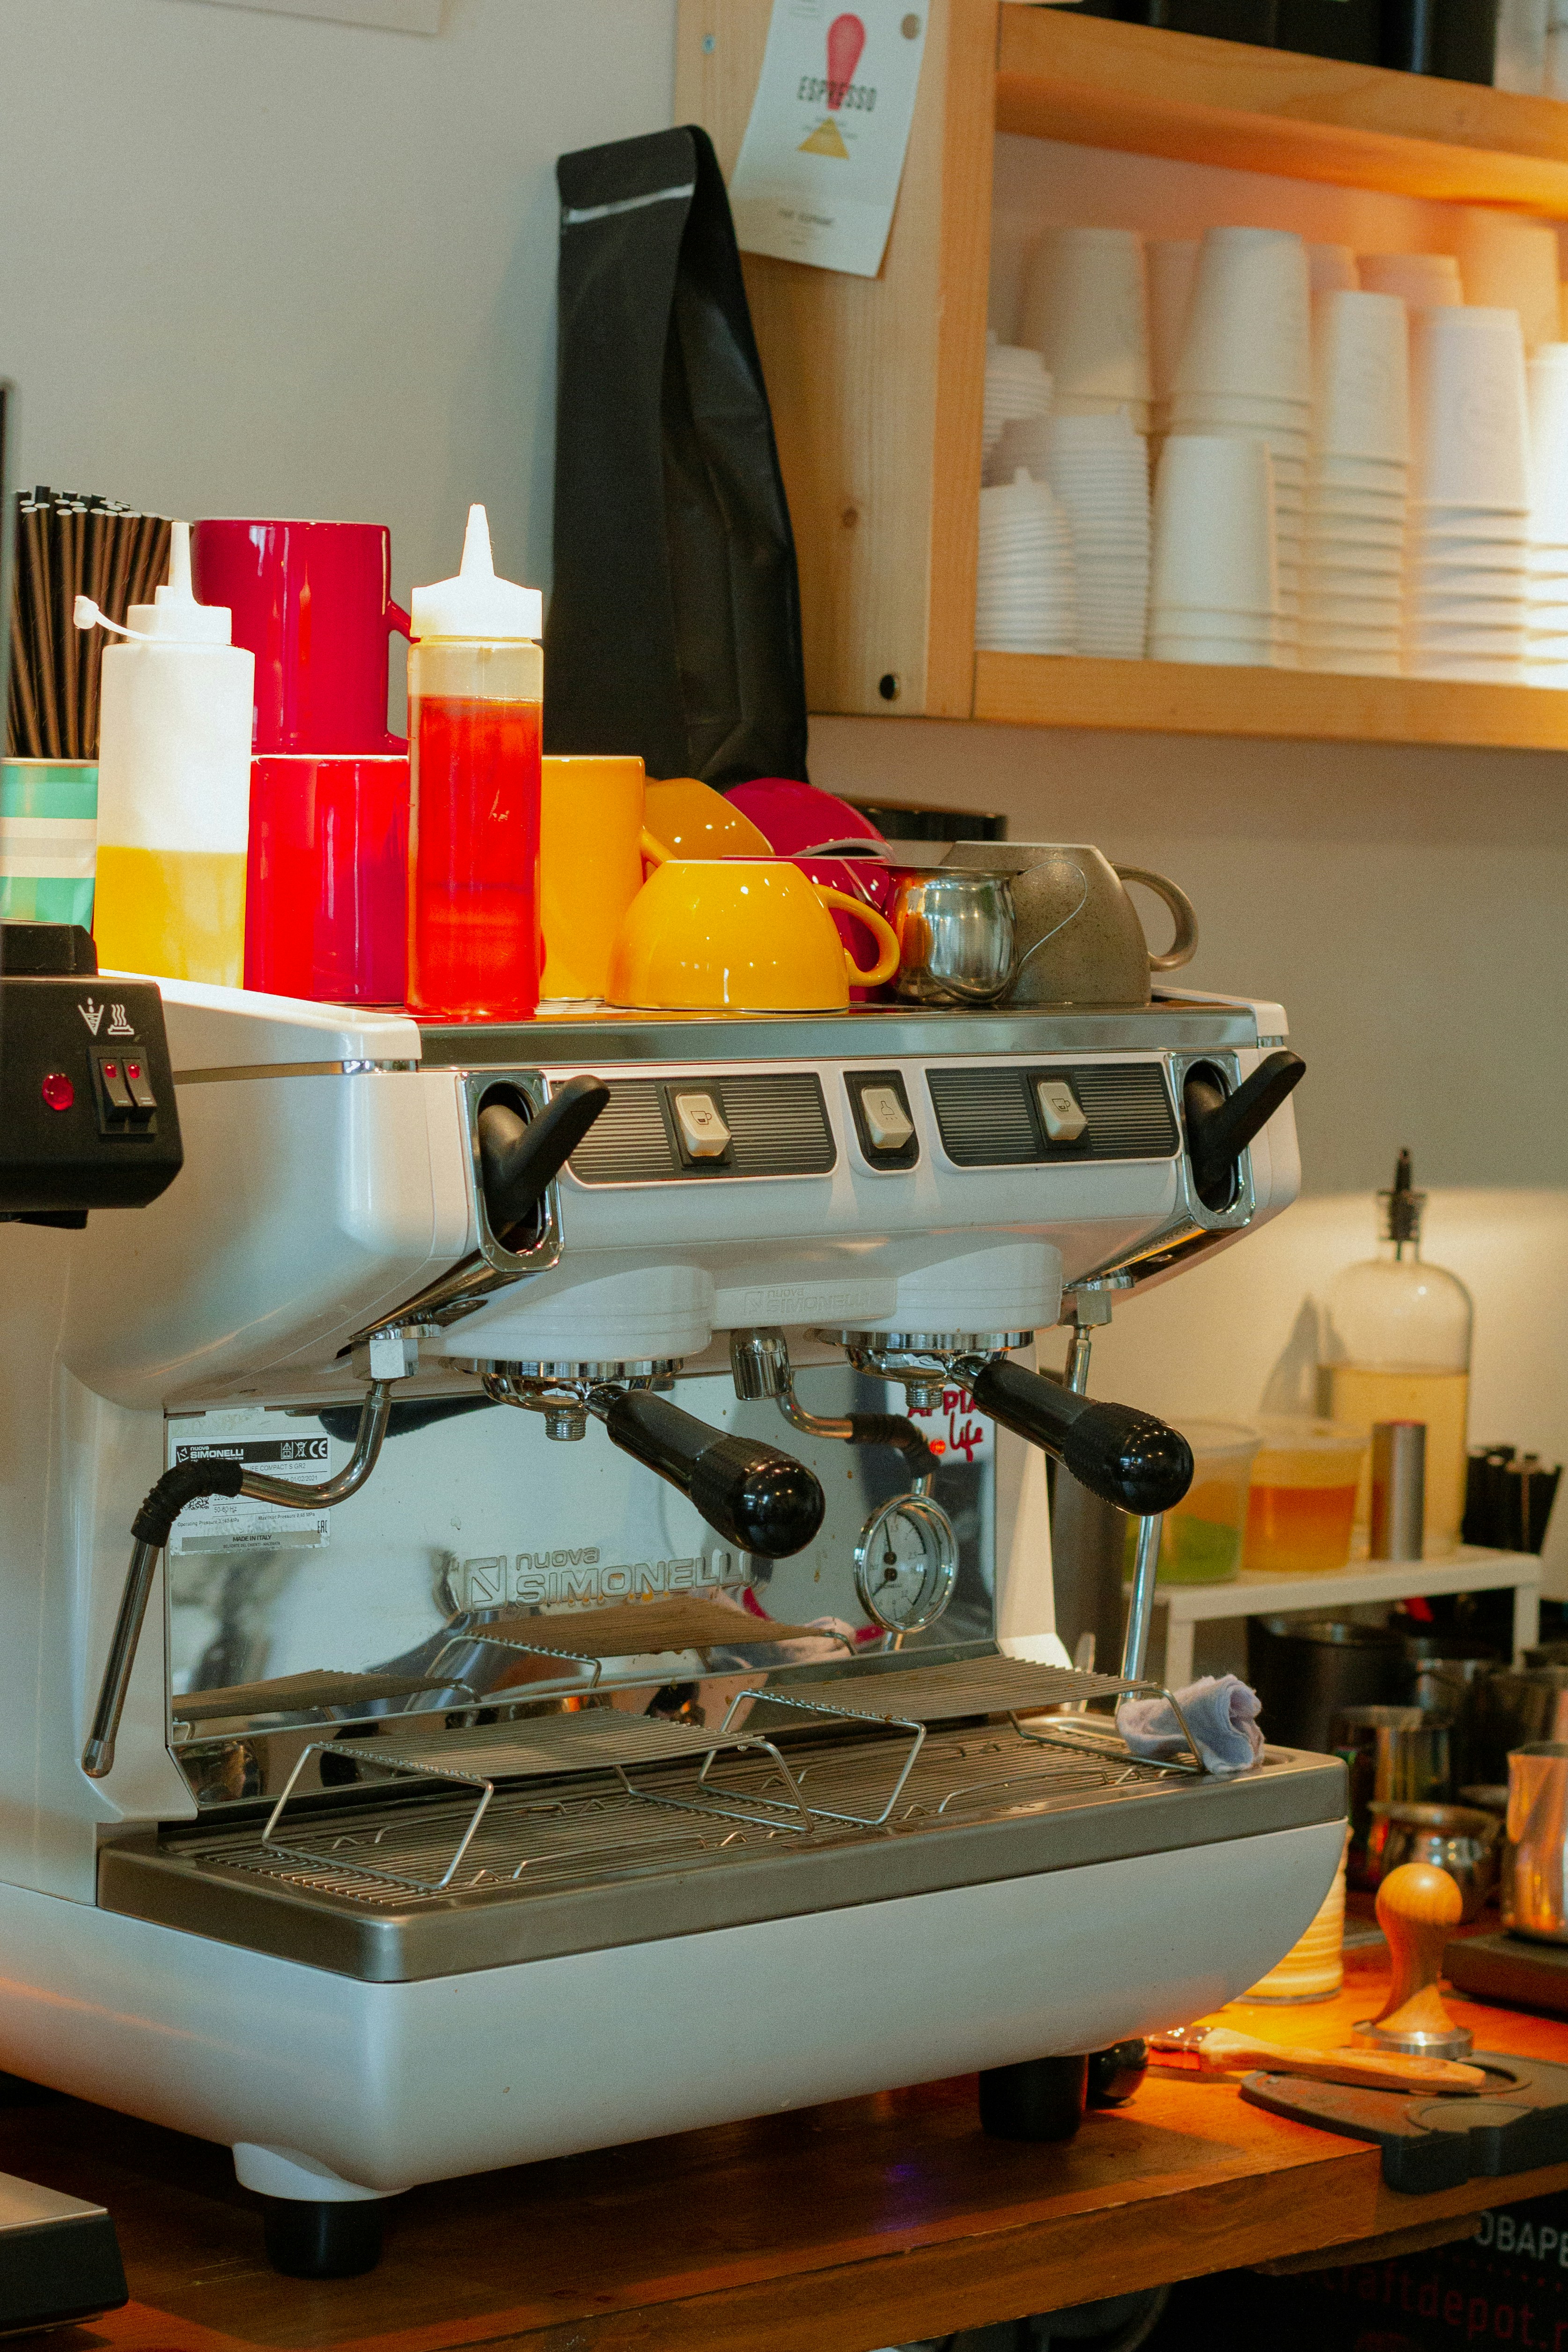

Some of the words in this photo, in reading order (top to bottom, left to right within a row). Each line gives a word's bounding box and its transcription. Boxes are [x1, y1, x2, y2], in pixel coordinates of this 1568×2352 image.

[190, 1449, 244, 1459] SIMONELLI
[516, 1546, 601, 1570] nuova
[515, 1551, 752, 1607] SIMONELLI
